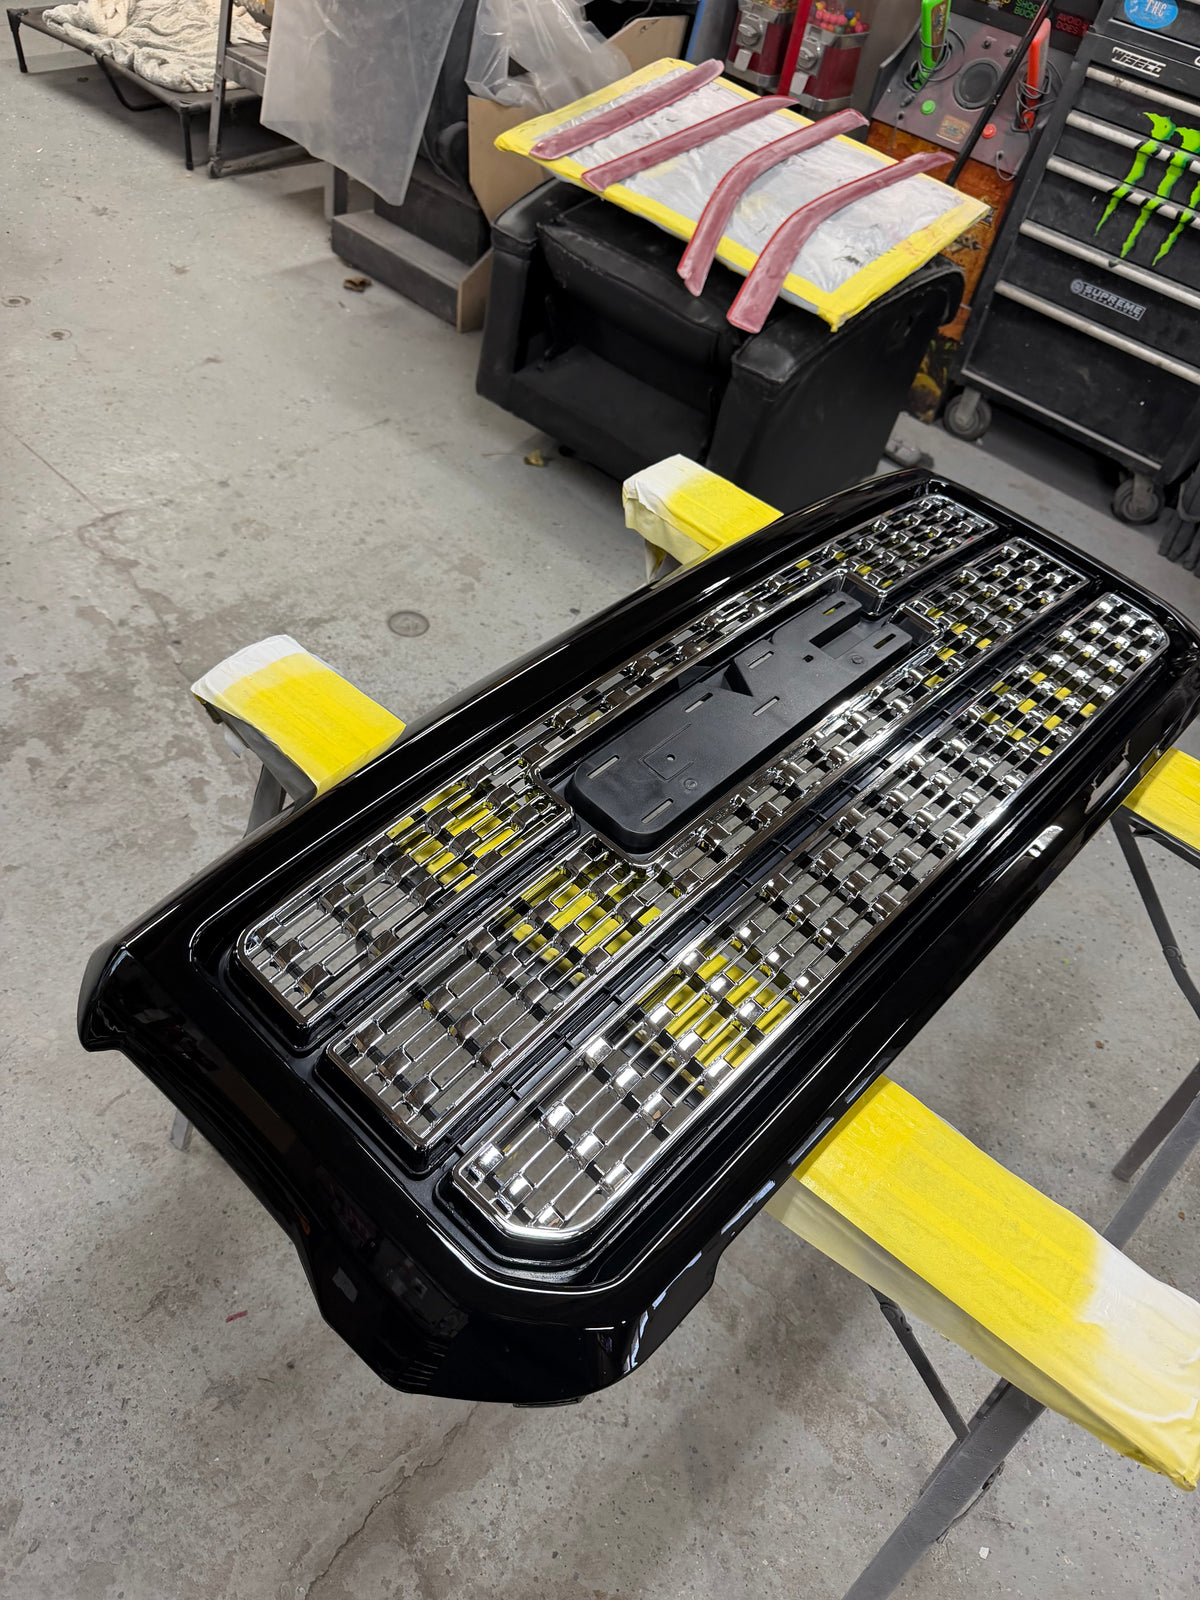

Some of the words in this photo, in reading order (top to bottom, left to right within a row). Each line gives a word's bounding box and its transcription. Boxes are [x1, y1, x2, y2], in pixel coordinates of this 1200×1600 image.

[1013, 6, 1035, 19] BUCK
[1015, 0, 1040, 12] SHOO
[1055, 21, 1080, 35] DOES
[1112, 47, 1165, 76] WISECO
[1084, 285, 1143, 314] SUPREME
